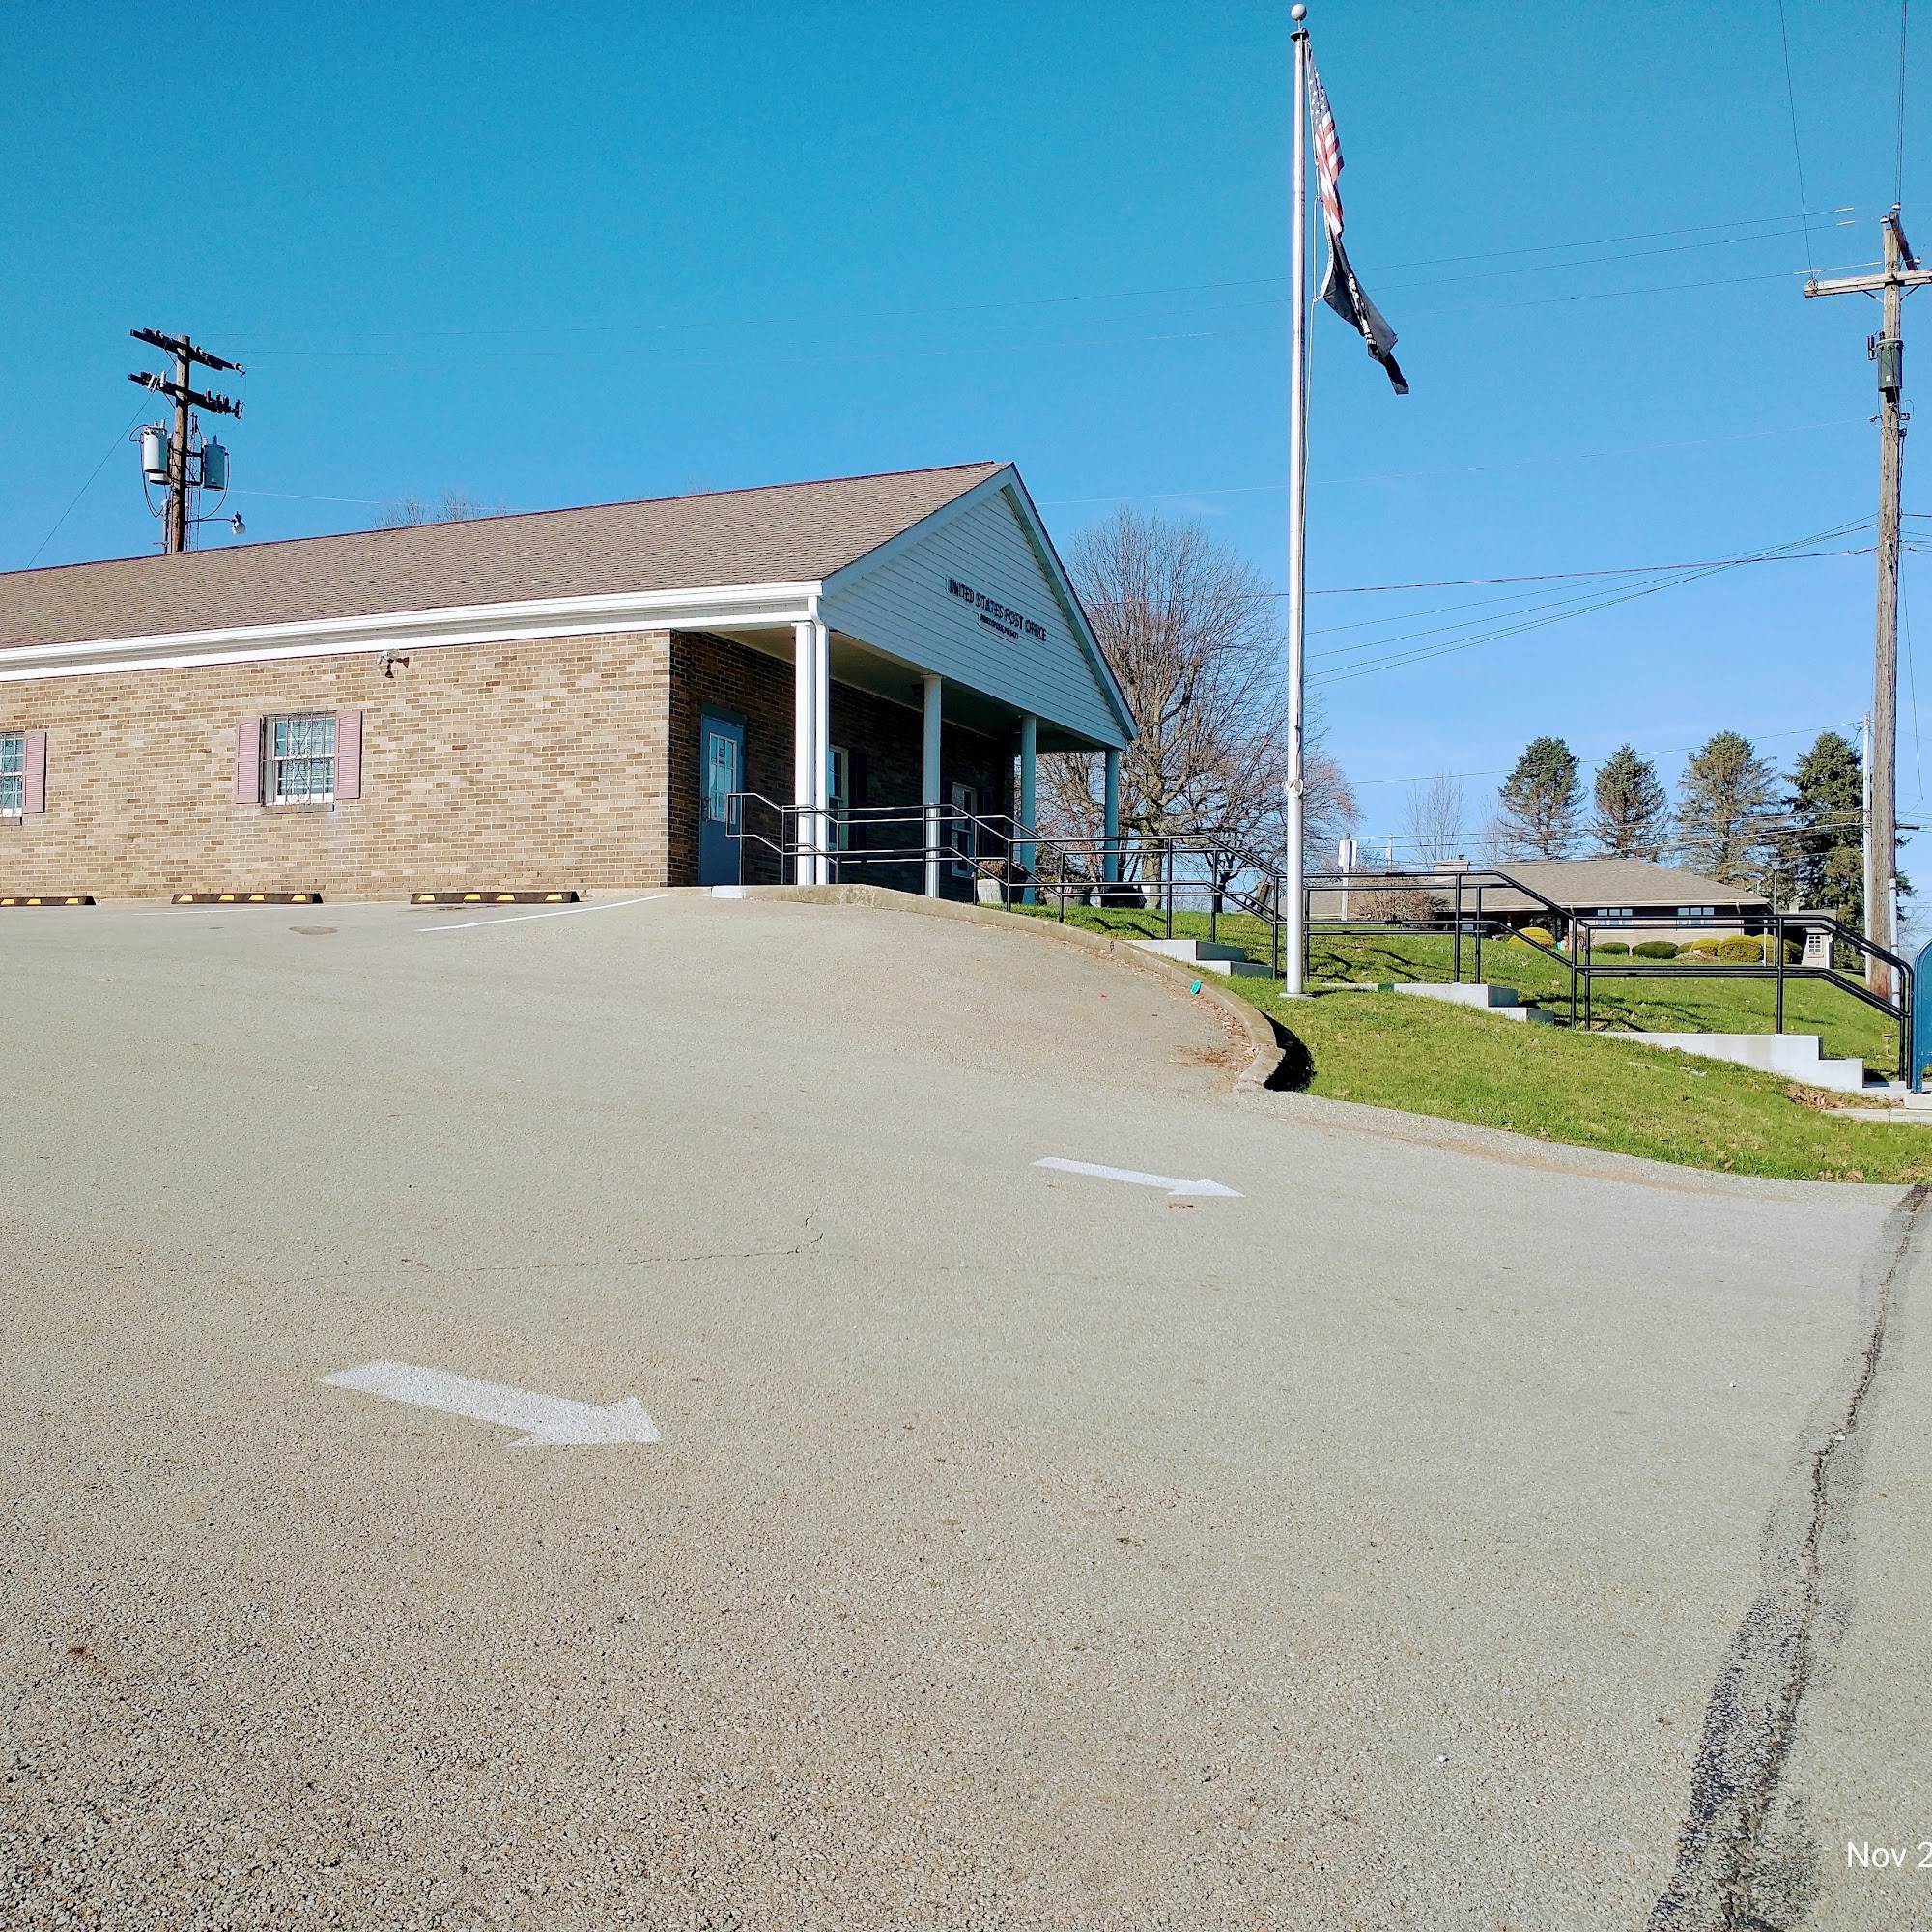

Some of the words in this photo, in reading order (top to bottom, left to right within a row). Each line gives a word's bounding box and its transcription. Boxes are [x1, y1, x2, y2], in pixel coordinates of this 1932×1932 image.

[949, 578, 975, 604] UNITED
[976, 592, 1004, 619] STATES
[1004, 608, 1024, 630] POST
[1025, 620, 1047, 642] OFFICE
